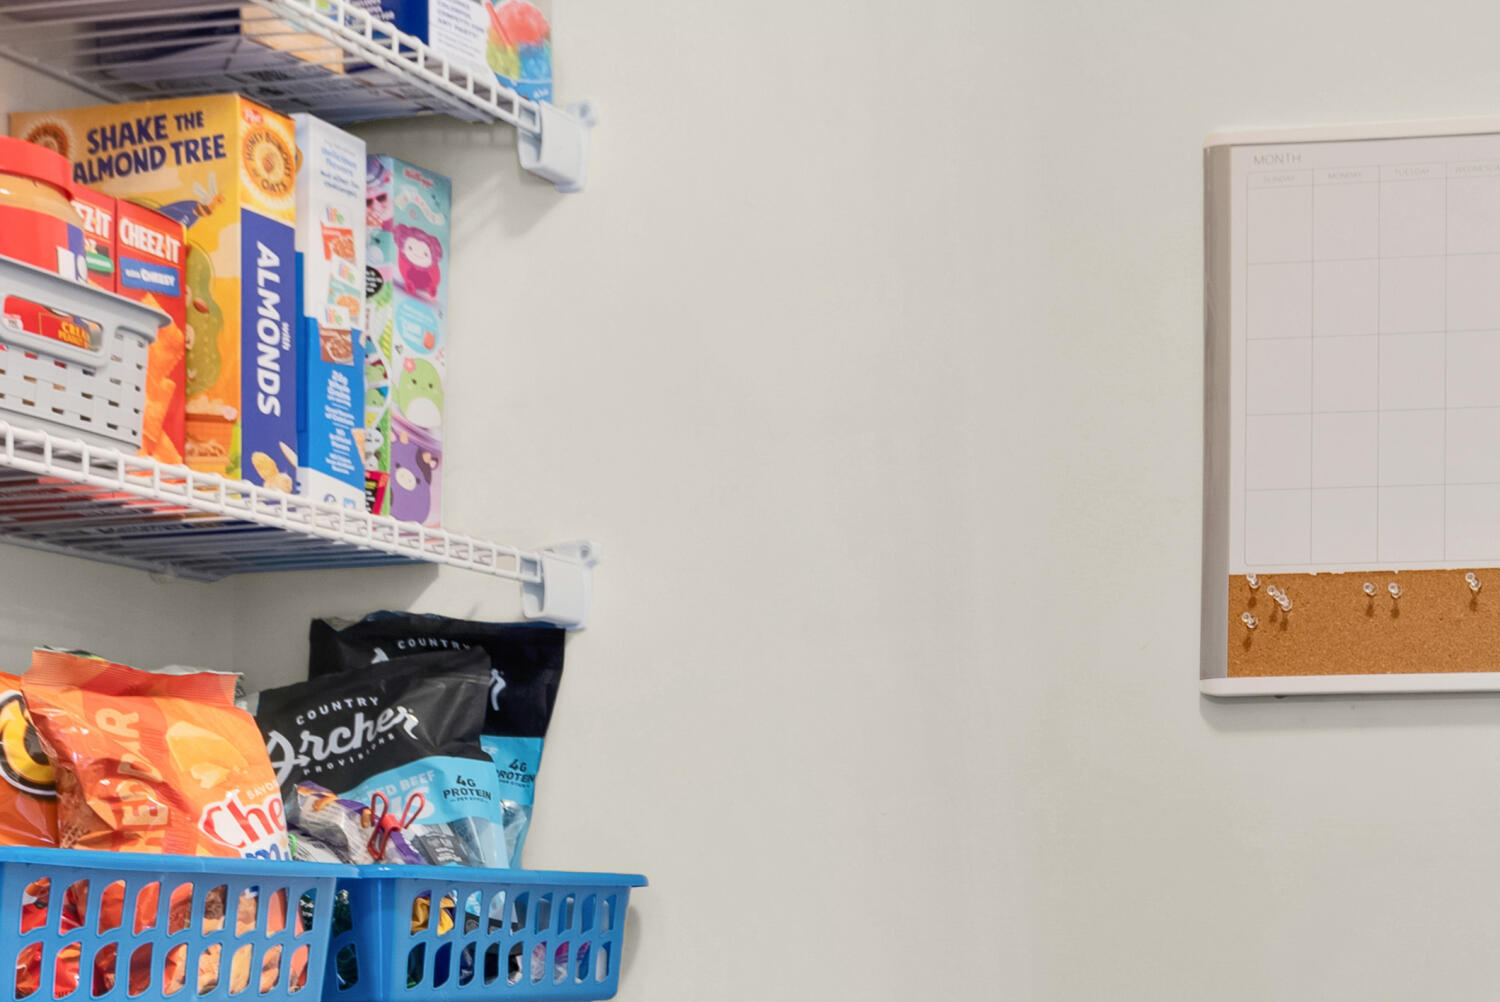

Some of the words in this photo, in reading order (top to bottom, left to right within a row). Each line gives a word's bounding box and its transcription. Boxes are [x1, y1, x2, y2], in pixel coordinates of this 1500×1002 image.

[87, 114, 168, 155] SHAKE
[175, 111, 204, 131] THE
[73, 145, 167, 185] ALMOND
[171, 134, 227, 166] TREE
[1253, 153, 1302, 167] MONTH
[261, 178, 287, 192] OATS
[119, 217, 181, 264] CHEEZ-IT
[257, 240, 281, 417] ALMONDS
[282, 321, 291, 351] with
[296, 697, 378, 726] COUNTRY
[267, 705, 420, 787] Archer
[303, 733, 395, 775] PROVISIONS
[401, 770, 436, 790] BEEF
[442, 786, 492, 801] PROTEIN
[456, 775, 476, 787] 4G
